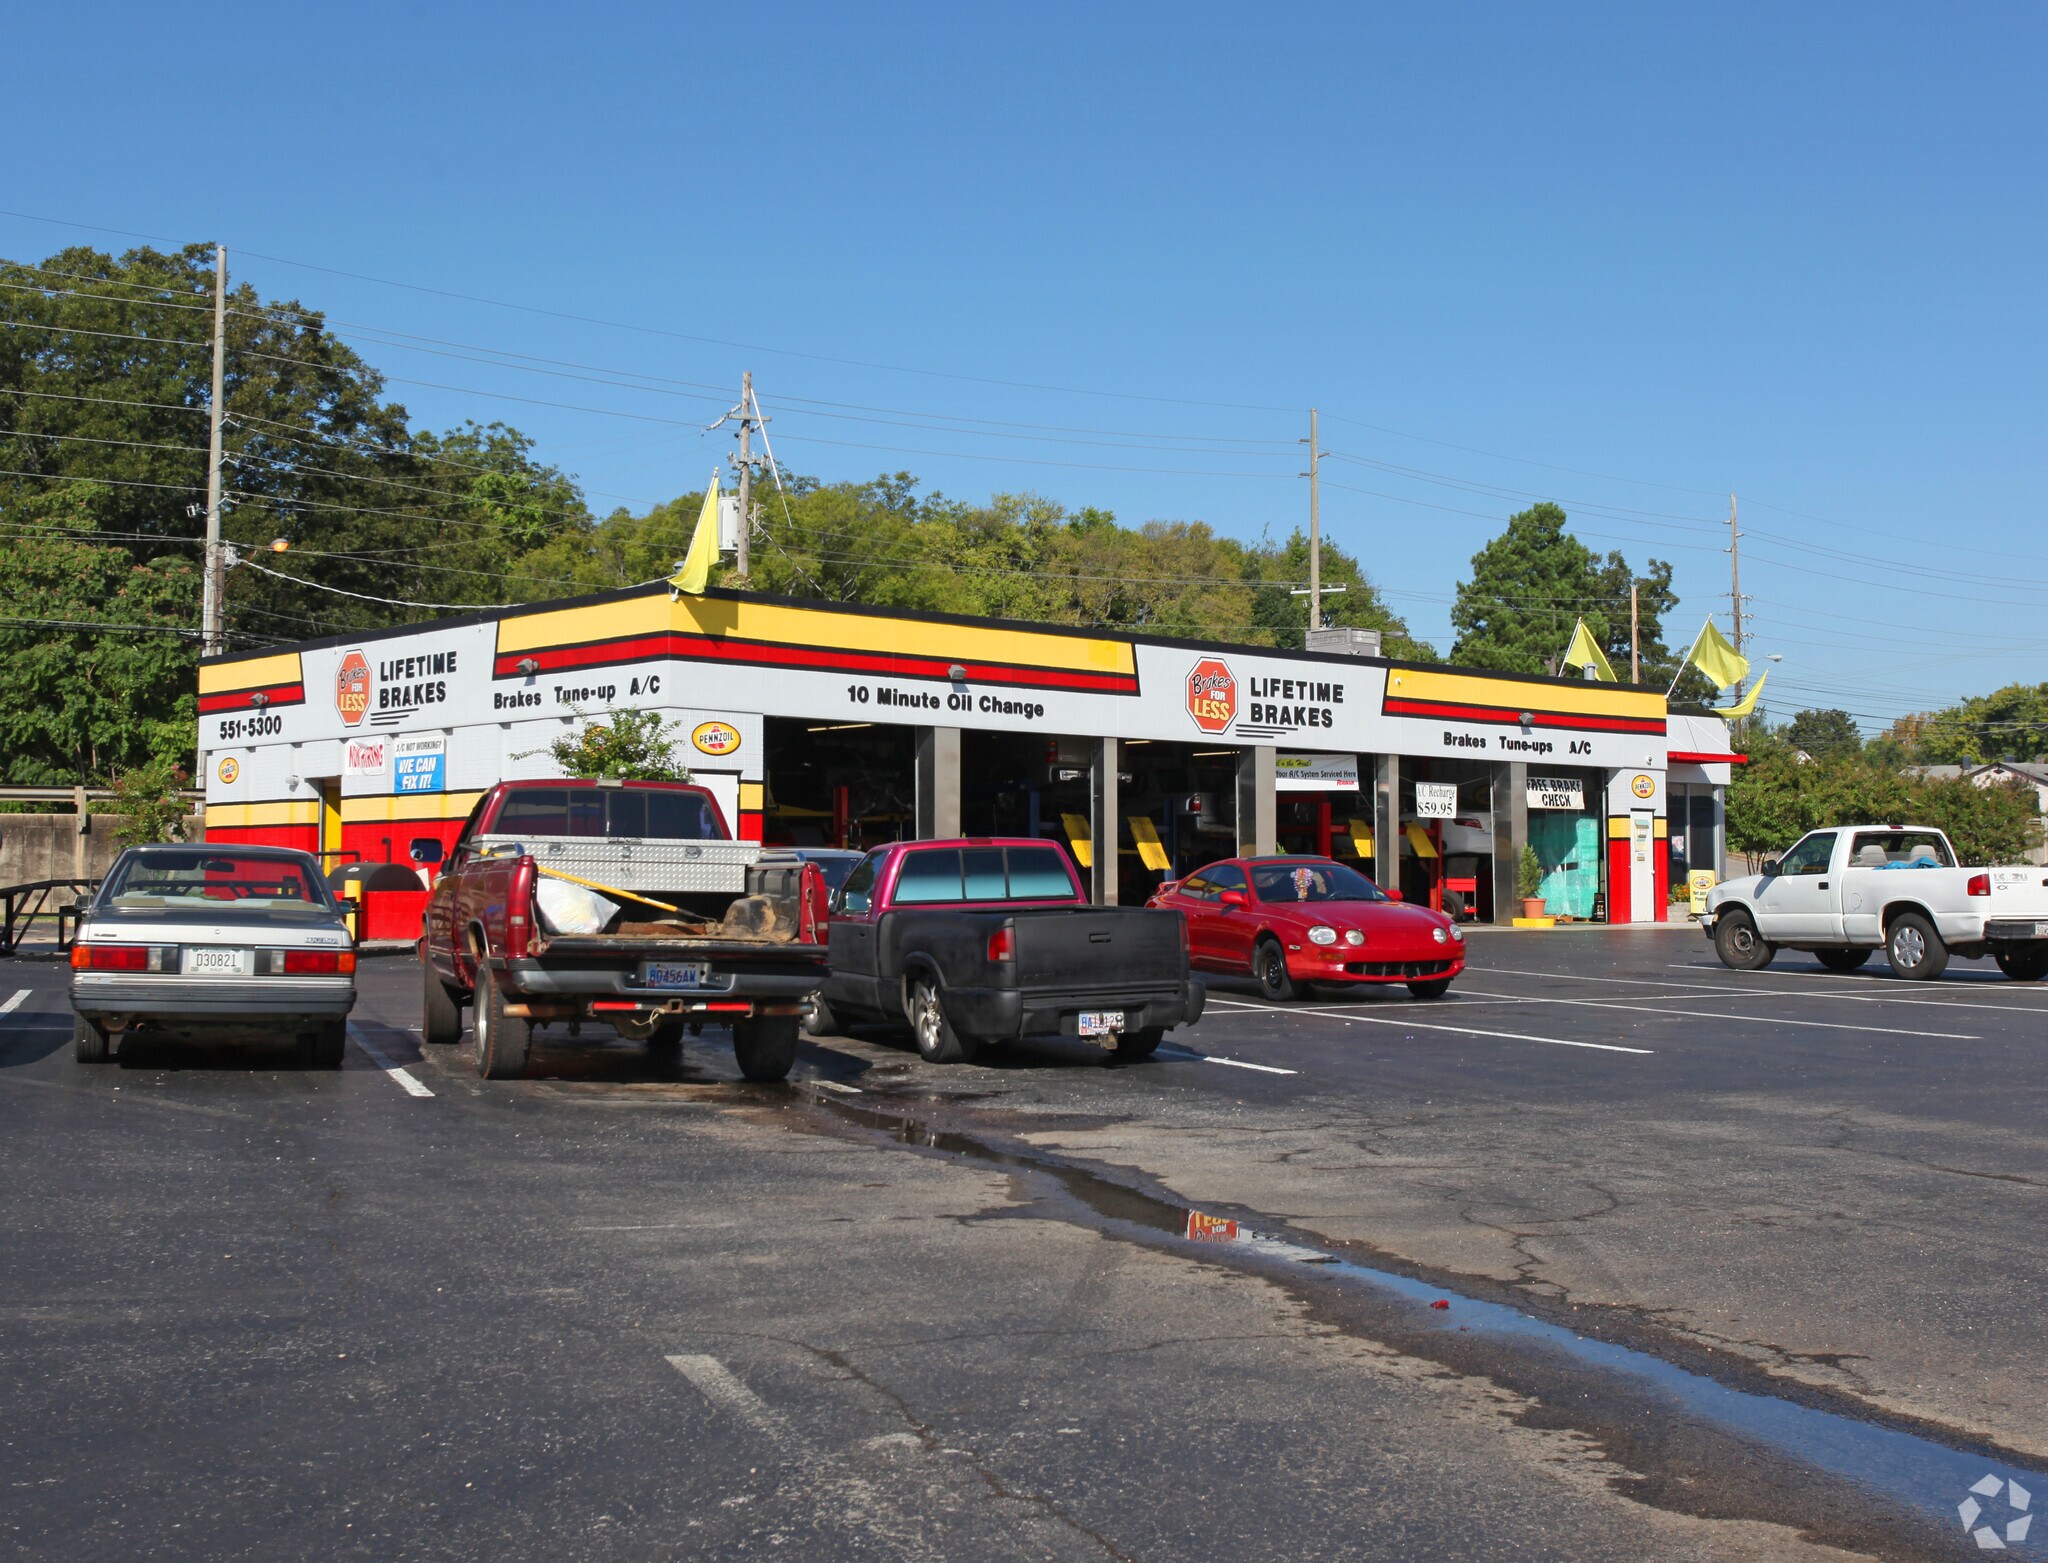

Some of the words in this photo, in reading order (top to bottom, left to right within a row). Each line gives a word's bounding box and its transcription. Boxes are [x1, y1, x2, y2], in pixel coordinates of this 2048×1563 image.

[380, 650, 457, 682] LIFETIME
[339, 662, 367, 690] Brakes
[1191, 670, 1231, 695] Brakes
[351, 682, 363, 692] FOR
[379, 681, 446, 709] BRAKES
[493, 690, 542, 710] Brakes
[554, 683, 616, 703] Tune-up
[630, 675, 661, 697] A/C
[1210, 689, 1226, 701] FOR
[1250, 676, 1344, 704] LIFETIME
[340, 693, 366, 712] LESS
[847, 685, 870, 703] 10
[877, 687, 940, 710] Minute
[946, 693, 973, 712] Oil
[978, 695, 1044, 720] Change
[1193, 698, 1230, 721] LESS
[1250, 702, 1333, 728] BRAKES
[219, 714, 282, 740] 551-5300
[698, 731, 735, 745] PENNZOIL
[1443, 731, 1486, 749] Brakes
[1499, 735, 1553, 756] Tune-ups
[1568, 740, 1592, 755] A/C
[406, 743, 416, 752] NOT
[398, 757, 414, 774] WE
[415, 756, 437, 773] CAN
[402, 775, 418, 790] FIX
[419, 774, 433, 789] IT!
[1276, 770, 1288, 778] Your
[1289, 770, 1299, 779] A/C
[1301, 770, 1320, 779] System
[1321, 770, 1342, 778] Serviced
[1343, 770, 1356, 778] Here
[1428, 785, 1455, 801] Recharge
[1550, 778, 1582, 793] BRAKE
[1417, 801, 1453, 816] $59.95
[1541, 793, 1572, 807] CHECK
[1993, 873, 2028, 881] ISZU
